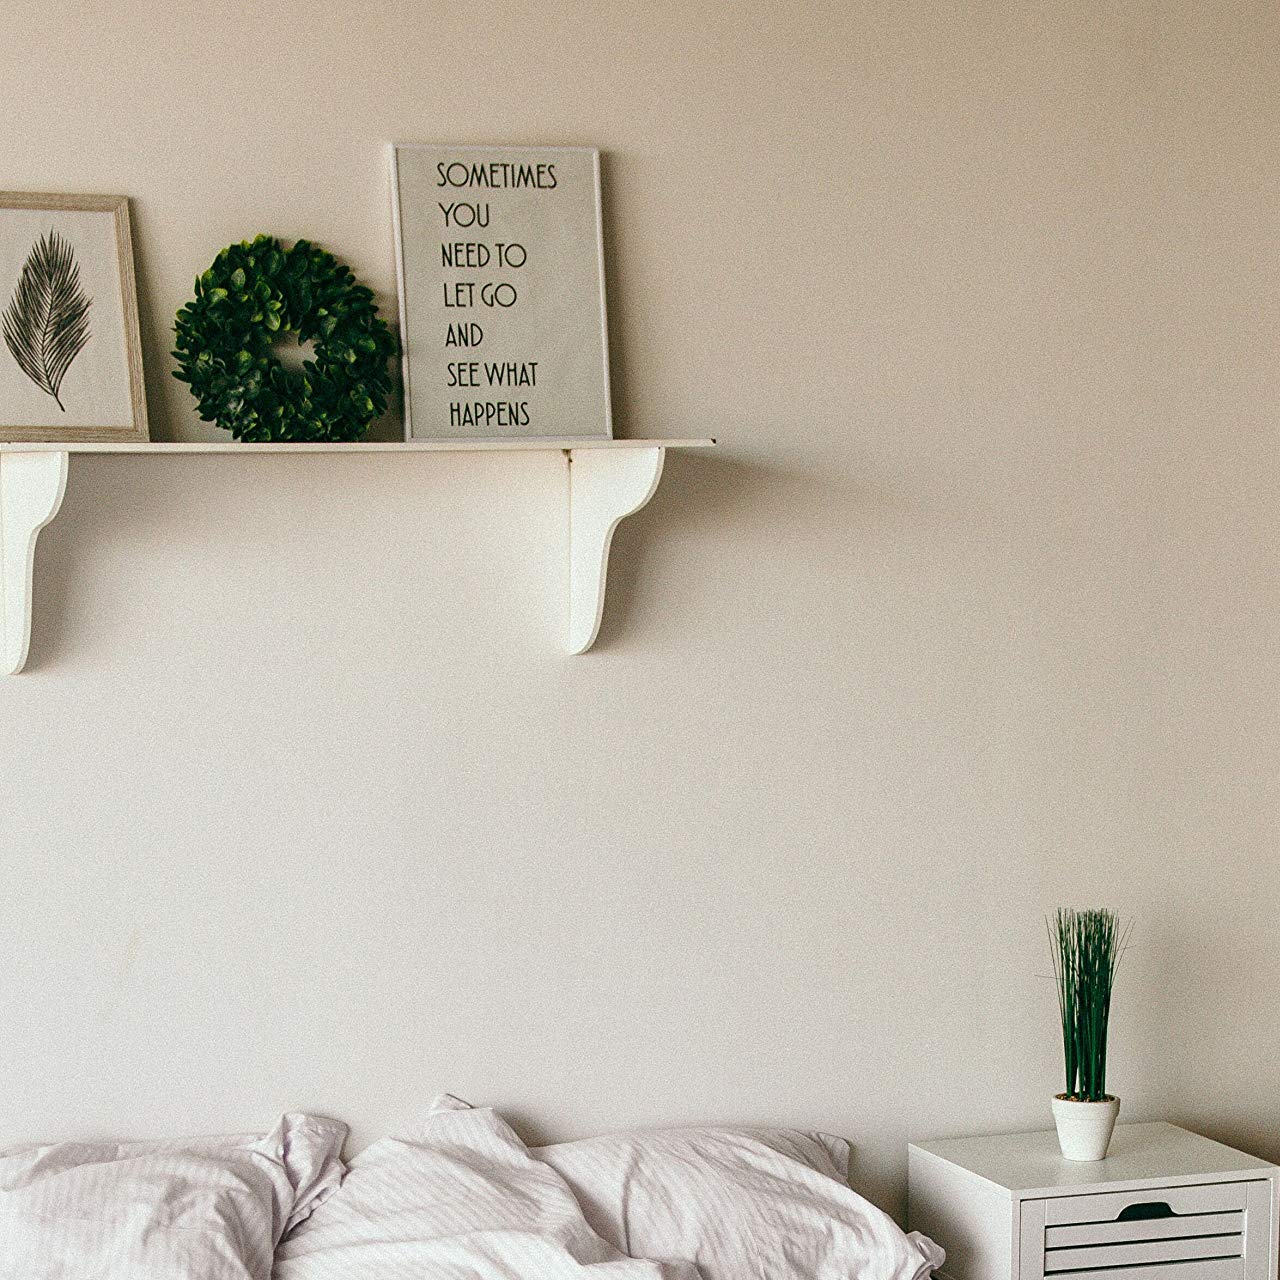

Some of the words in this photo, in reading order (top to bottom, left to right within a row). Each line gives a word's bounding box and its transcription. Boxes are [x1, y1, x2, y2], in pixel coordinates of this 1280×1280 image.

[436, 161, 558, 190] SOMETIMES
[438, 202, 490, 228] YOU
[441, 242, 491, 268] NEED
[494, 243, 528, 269] TO
[443, 282, 476, 308] LET
[480, 282, 518, 308] GO
[445, 322, 484, 348] AND
[447, 362, 481, 387] SEE
[483, 362, 538, 387] WHAT
[449, 401, 530, 427] HAPPENS
